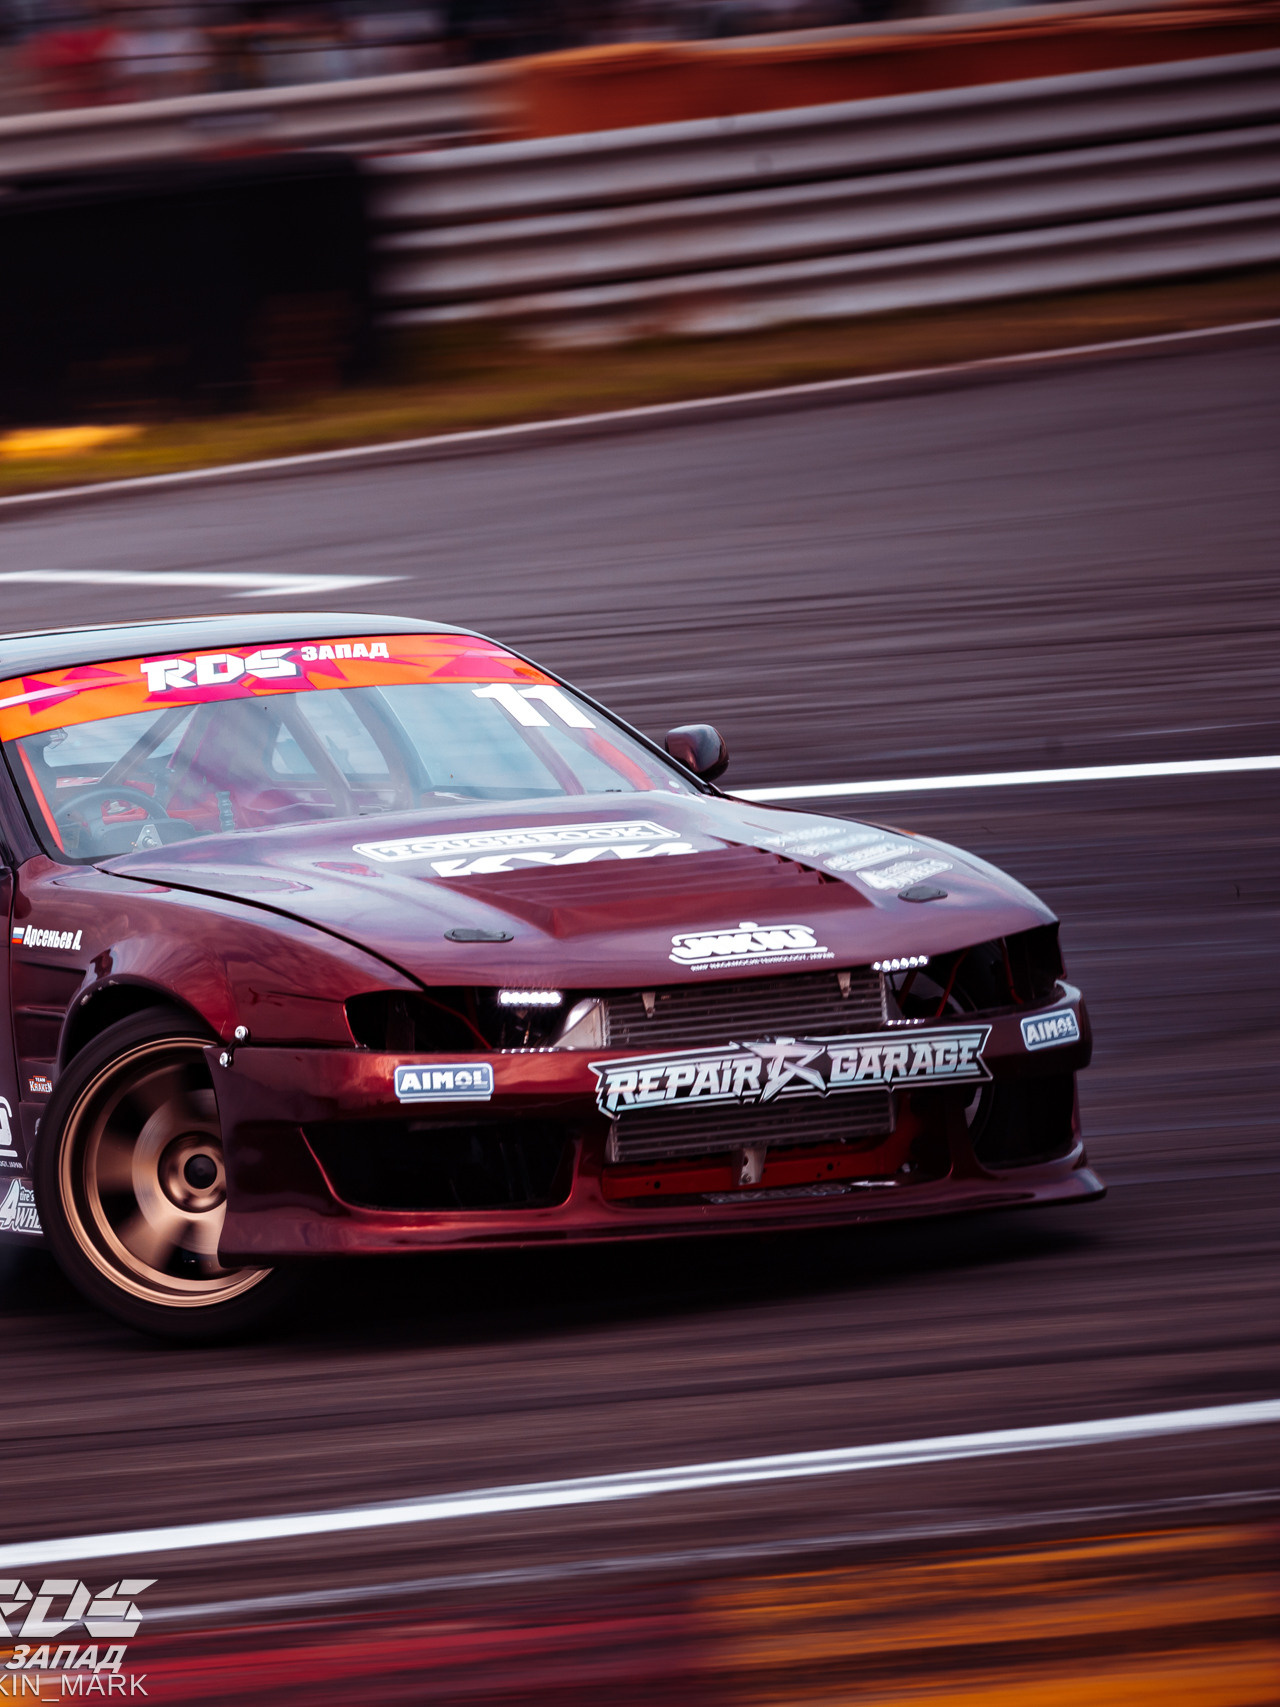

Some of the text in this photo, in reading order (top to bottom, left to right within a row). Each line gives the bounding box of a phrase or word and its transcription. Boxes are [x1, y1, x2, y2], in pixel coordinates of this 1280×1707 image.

[301, 642, 390, 661] ЗАПАД
[140, 647, 303, 692] RDS
[472, 683, 597, 729] 11
[23, 924, 74, 949] Арсеньев
[28, 1080, 53, 1093] KRAKEN
[399, 1070, 489, 1092] AIMOL
[606, 1056, 764, 1113] REPAIR
[827, 1040, 982, 1083] GARAGE
